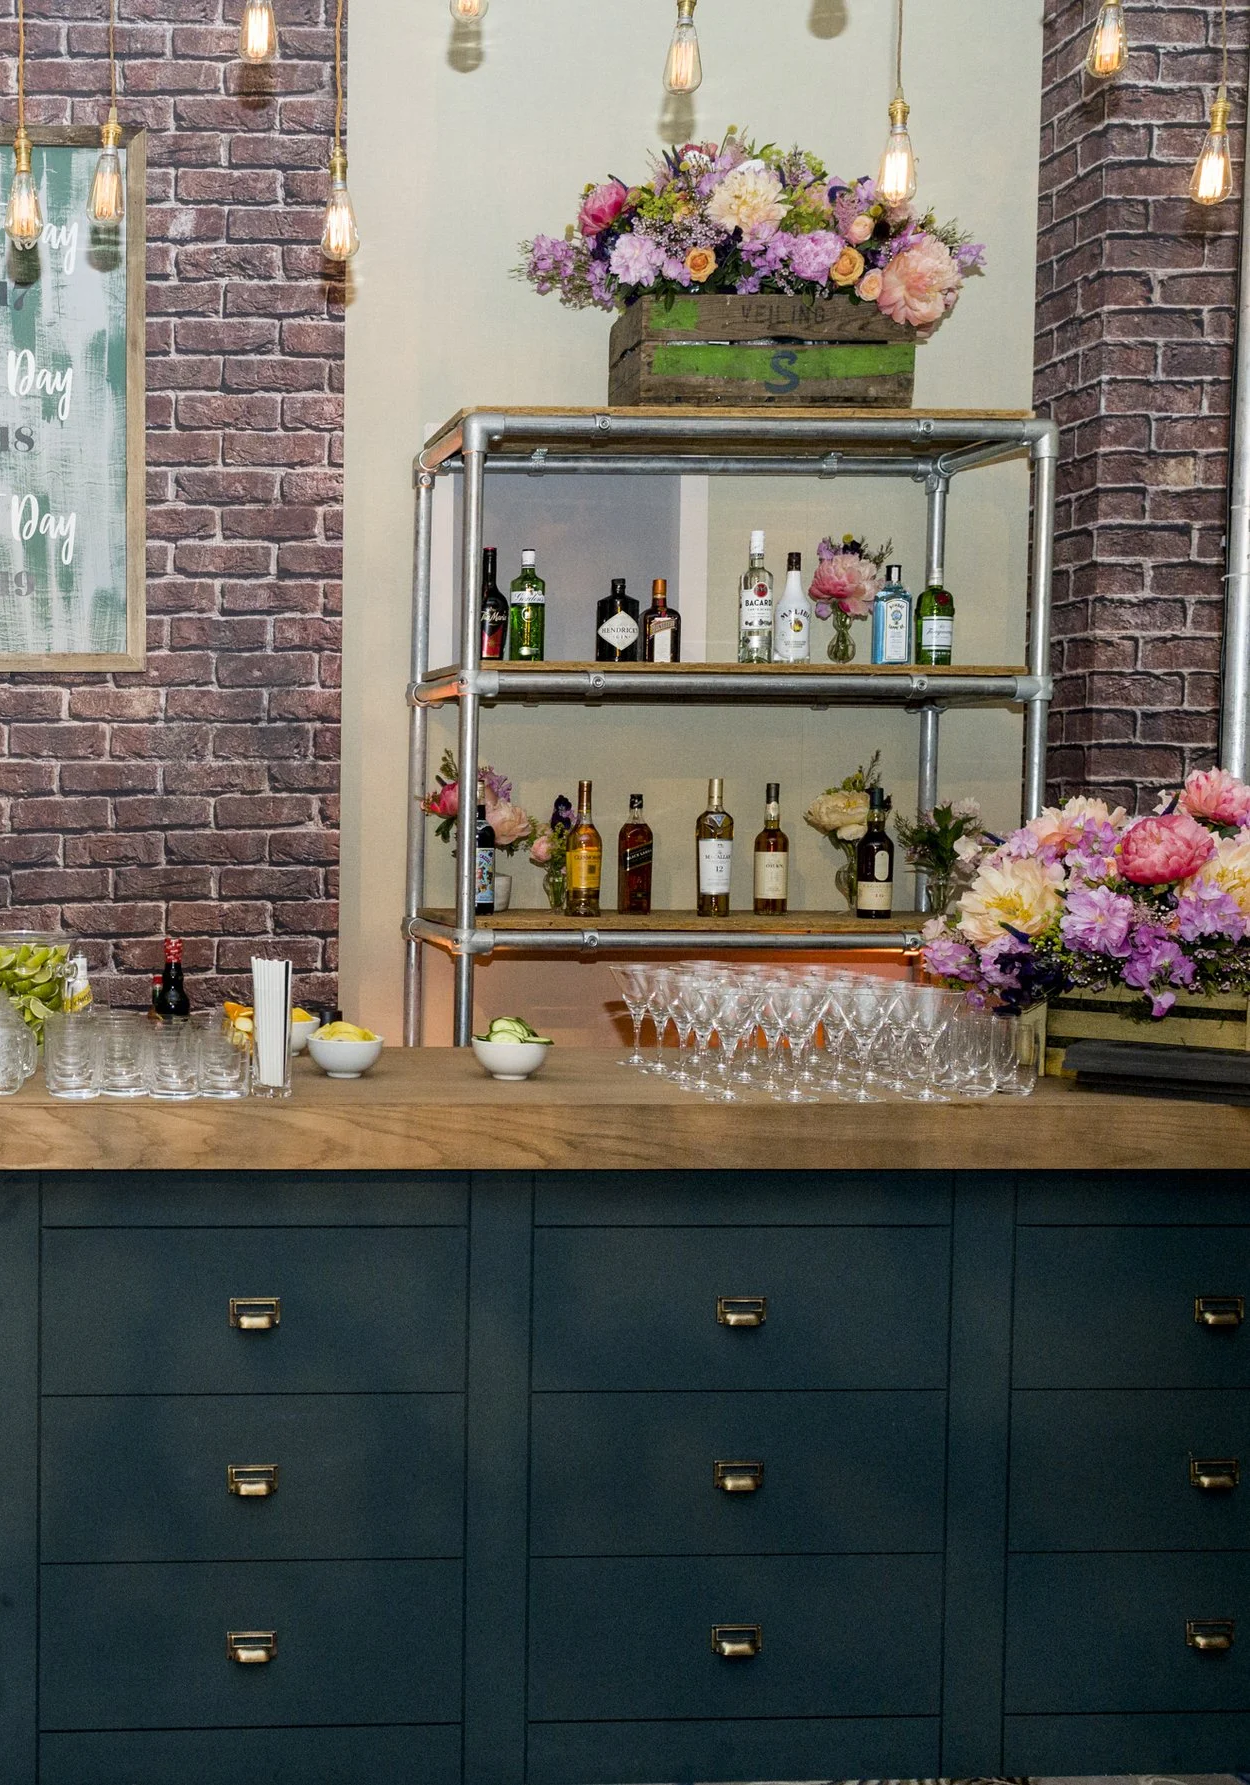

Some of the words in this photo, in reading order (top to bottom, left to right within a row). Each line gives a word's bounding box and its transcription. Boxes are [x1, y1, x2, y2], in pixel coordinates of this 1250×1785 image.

[12, 218, 78, 275] ay
[7, 348, 73, 421] Day
[764, 349, 800, 394] S
[11, 493, 77, 566] Day
[745, 599, 773, 607] BACARD
